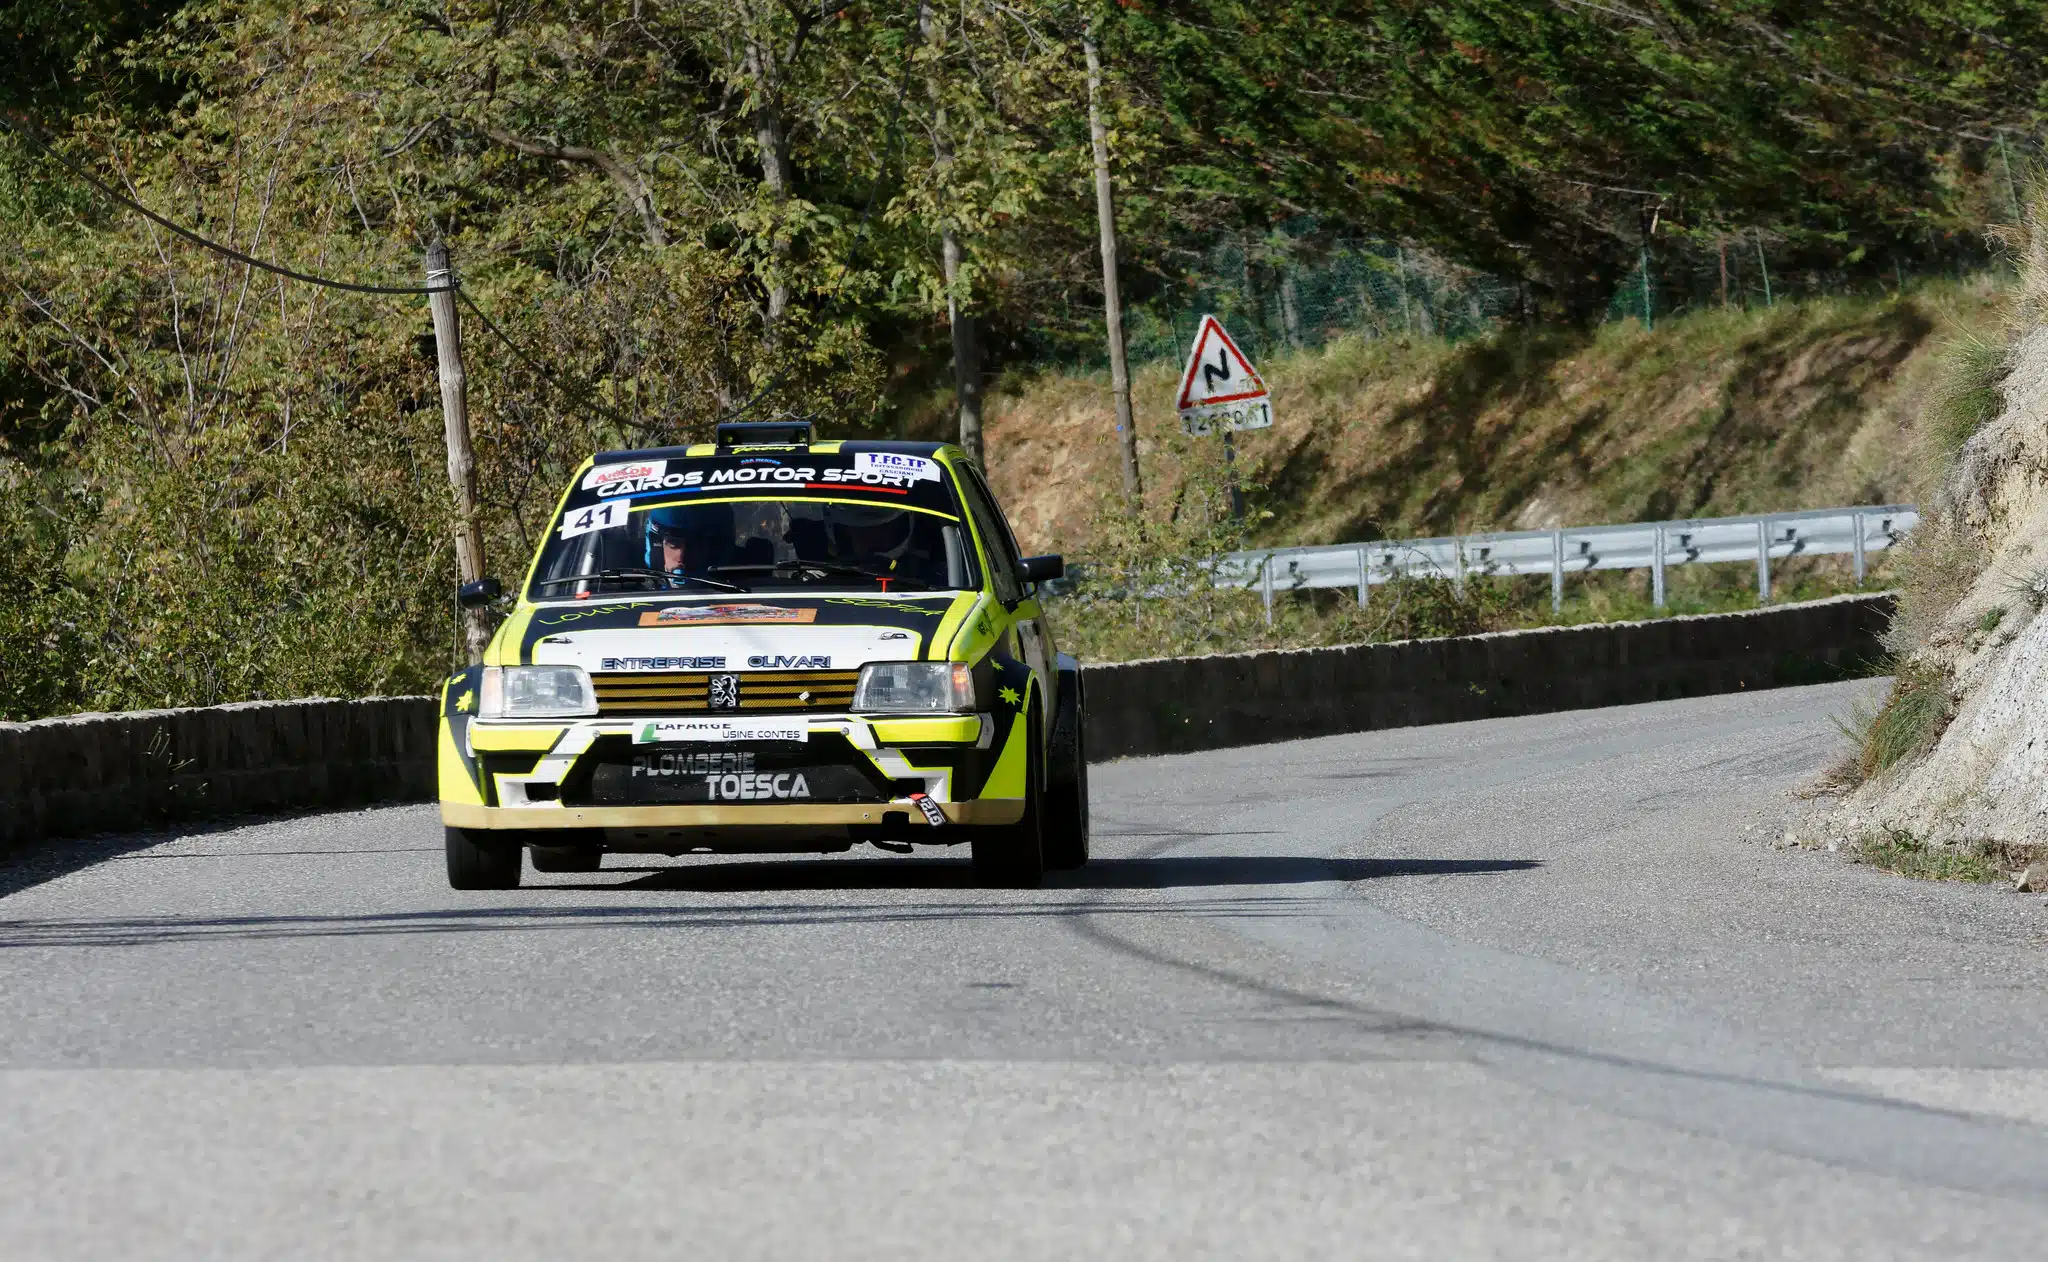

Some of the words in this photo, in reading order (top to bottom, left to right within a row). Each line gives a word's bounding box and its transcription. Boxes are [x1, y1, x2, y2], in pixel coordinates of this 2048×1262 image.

[597, 471, 704, 497] CAIROS
[708, 468, 816, 484] MOTOR
[821, 469, 920, 488] SPORT
[574, 505, 613, 530] 41
[601, 656, 727, 670] ENTREPRISE
[747, 655, 832, 668] OLIVARI
[722, 730, 754, 739] USINE
[757, 730, 801, 739] CONTES
[632, 752, 756, 777] PLOMBERIE
[705, 773, 811, 800] TOESCA
